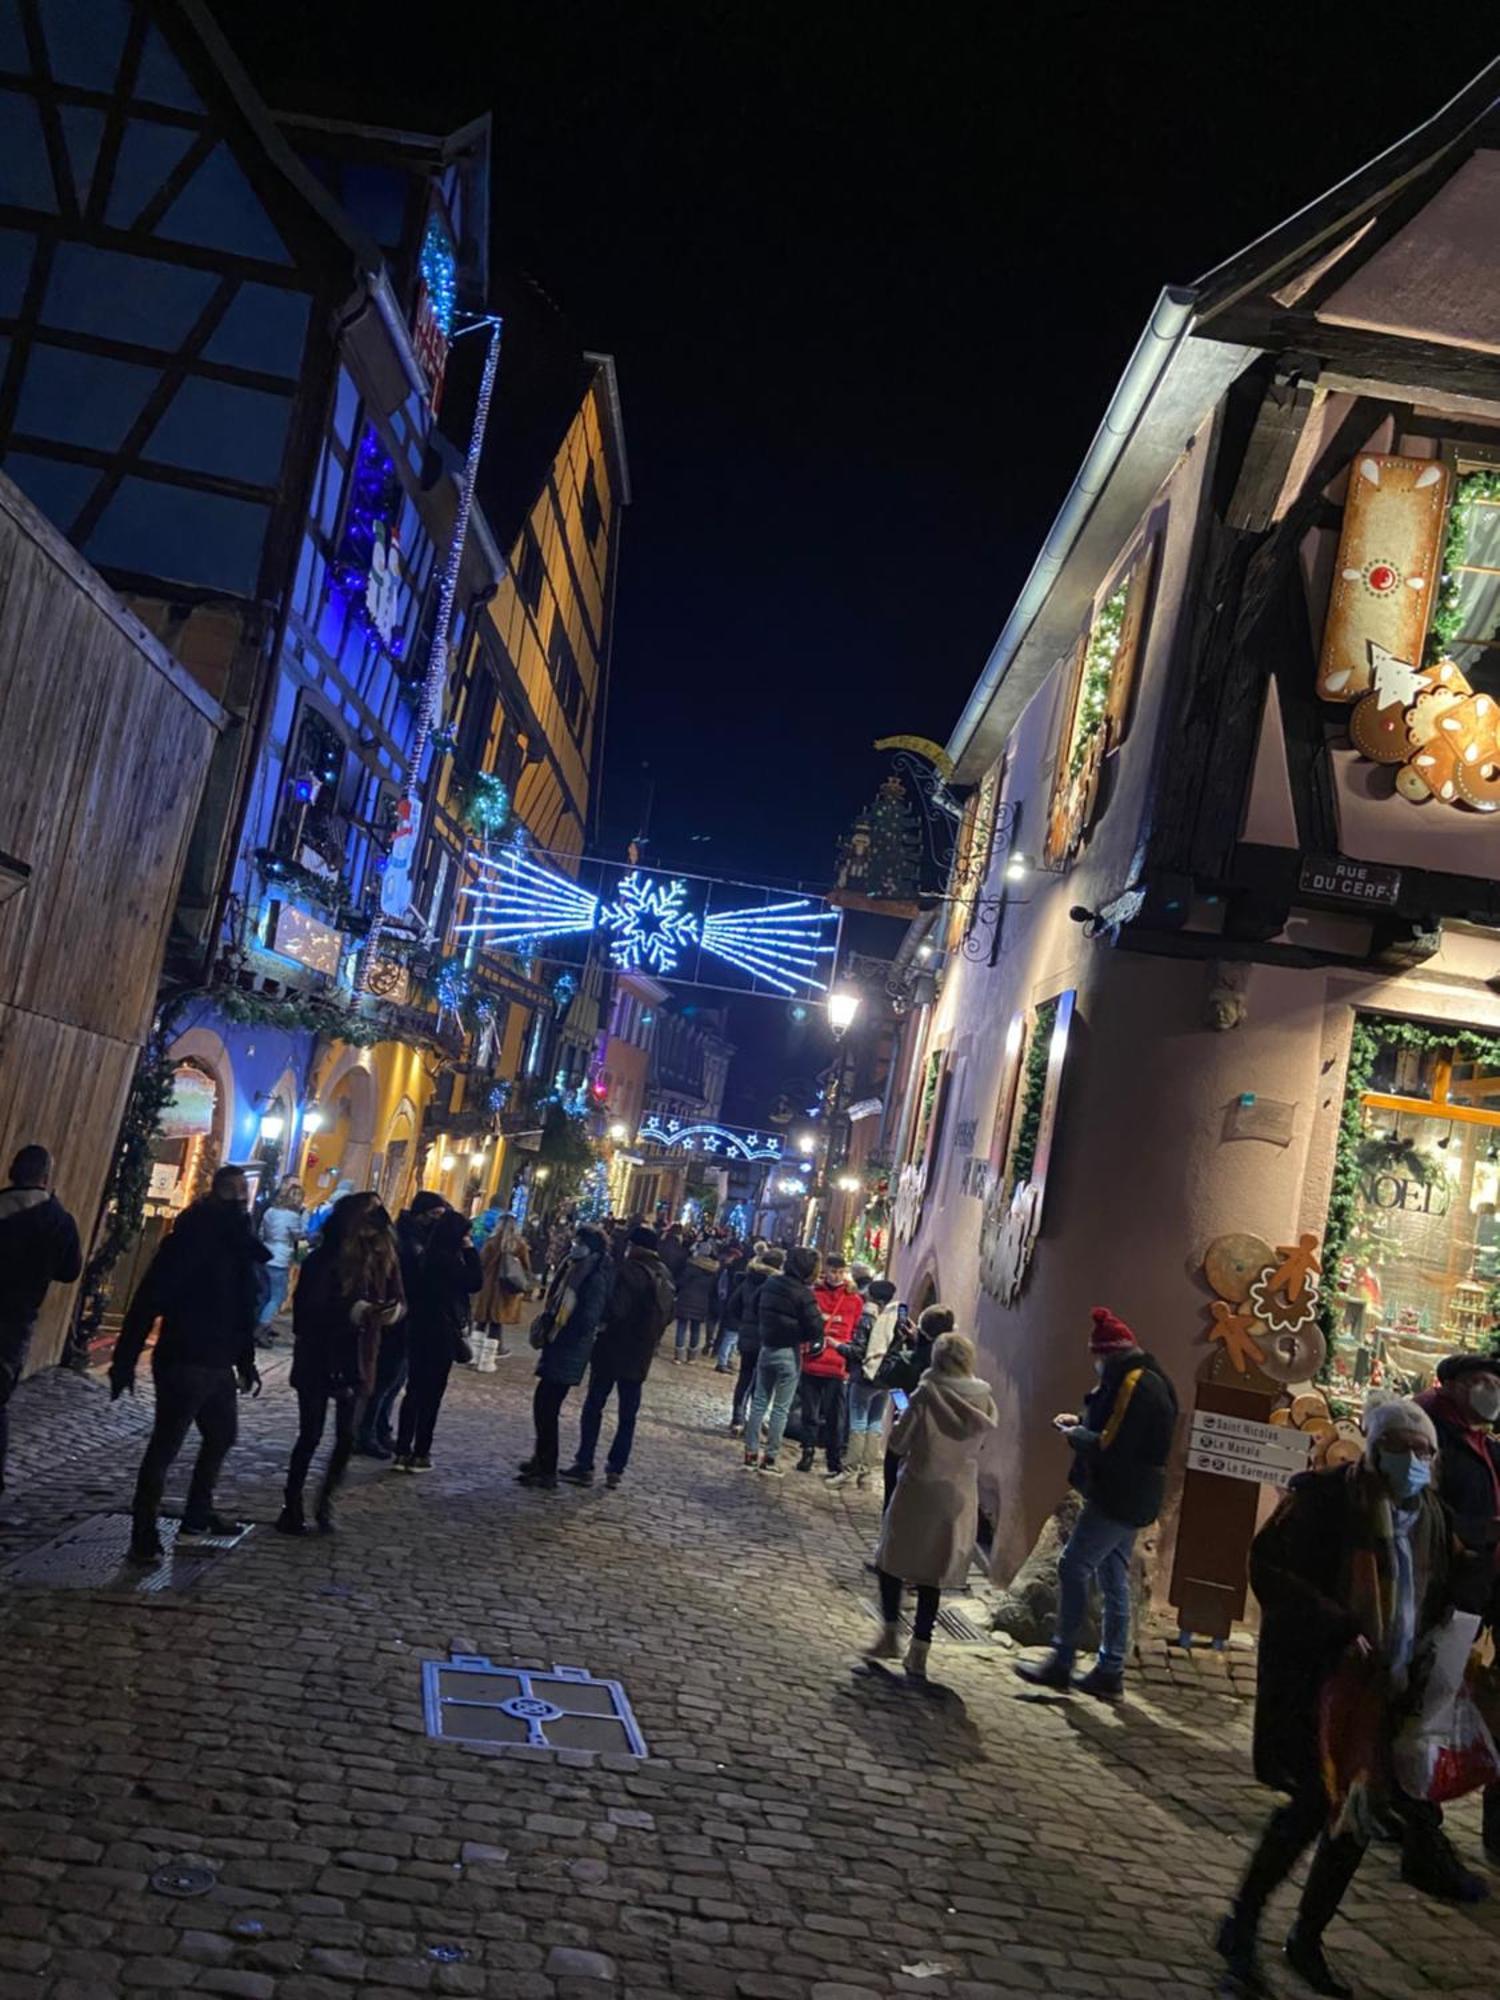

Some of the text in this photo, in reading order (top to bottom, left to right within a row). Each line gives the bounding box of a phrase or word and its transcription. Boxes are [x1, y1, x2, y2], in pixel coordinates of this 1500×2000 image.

[1335, 864, 1369, 880] RUE
[1312, 874, 1387, 898] DU CERF
[1217, 1418, 1278, 1441] Saint Nicolas
[1213, 1439, 1224, 1449] Le
[1227, 1460, 1238, 1473] Le
[1241, 1464, 1278, 1481] Sarment
